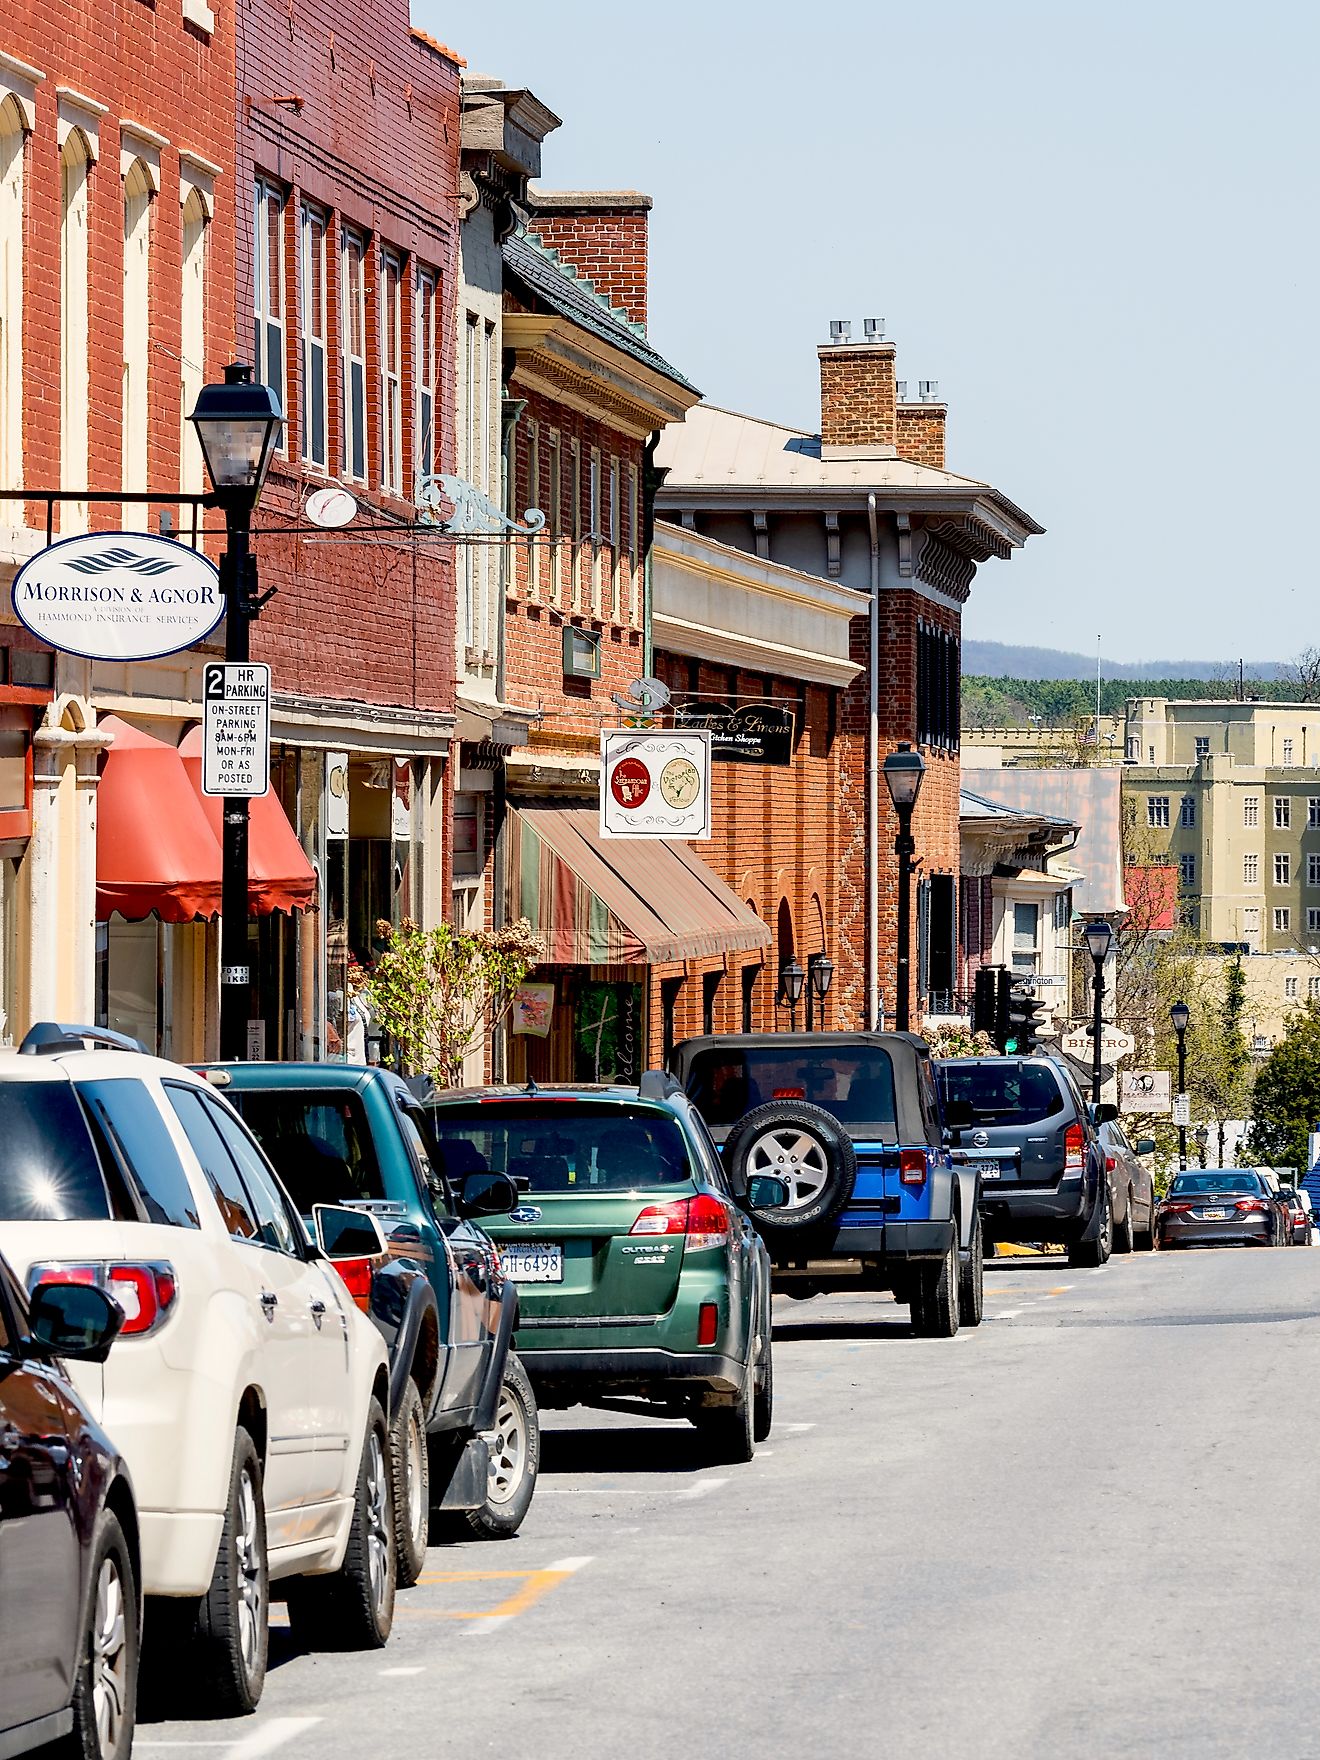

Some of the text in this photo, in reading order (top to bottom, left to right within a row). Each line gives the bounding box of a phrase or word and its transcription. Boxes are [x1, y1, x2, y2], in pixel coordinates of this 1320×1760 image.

[23, 582, 216, 604] MORRISON & AGNOR
[38, 612, 200, 624] HAMMOND INSURANCE SERVICES
[208, 669, 254, 694] 2 HR
[225, 684, 266, 698] PARKING
[211, 705, 262, 716] ON-STREET
[216, 719, 256, 729] PARKING
[727, 717, 743, 732] &
[742, 715, 791, 734] Linens
[214, 732, 257, 743] 8AM-6PM
[735, 733, 762, 745] Shoppe
[216, 746, 256, 757] MON-FRI
[221, 759, 250, 770] OR AS
[218, 773, 253, 784] POSTED
[508, 1246, 544, 1254] VIRGINIA
[501, 1254, 559, 1272] GH-6498
